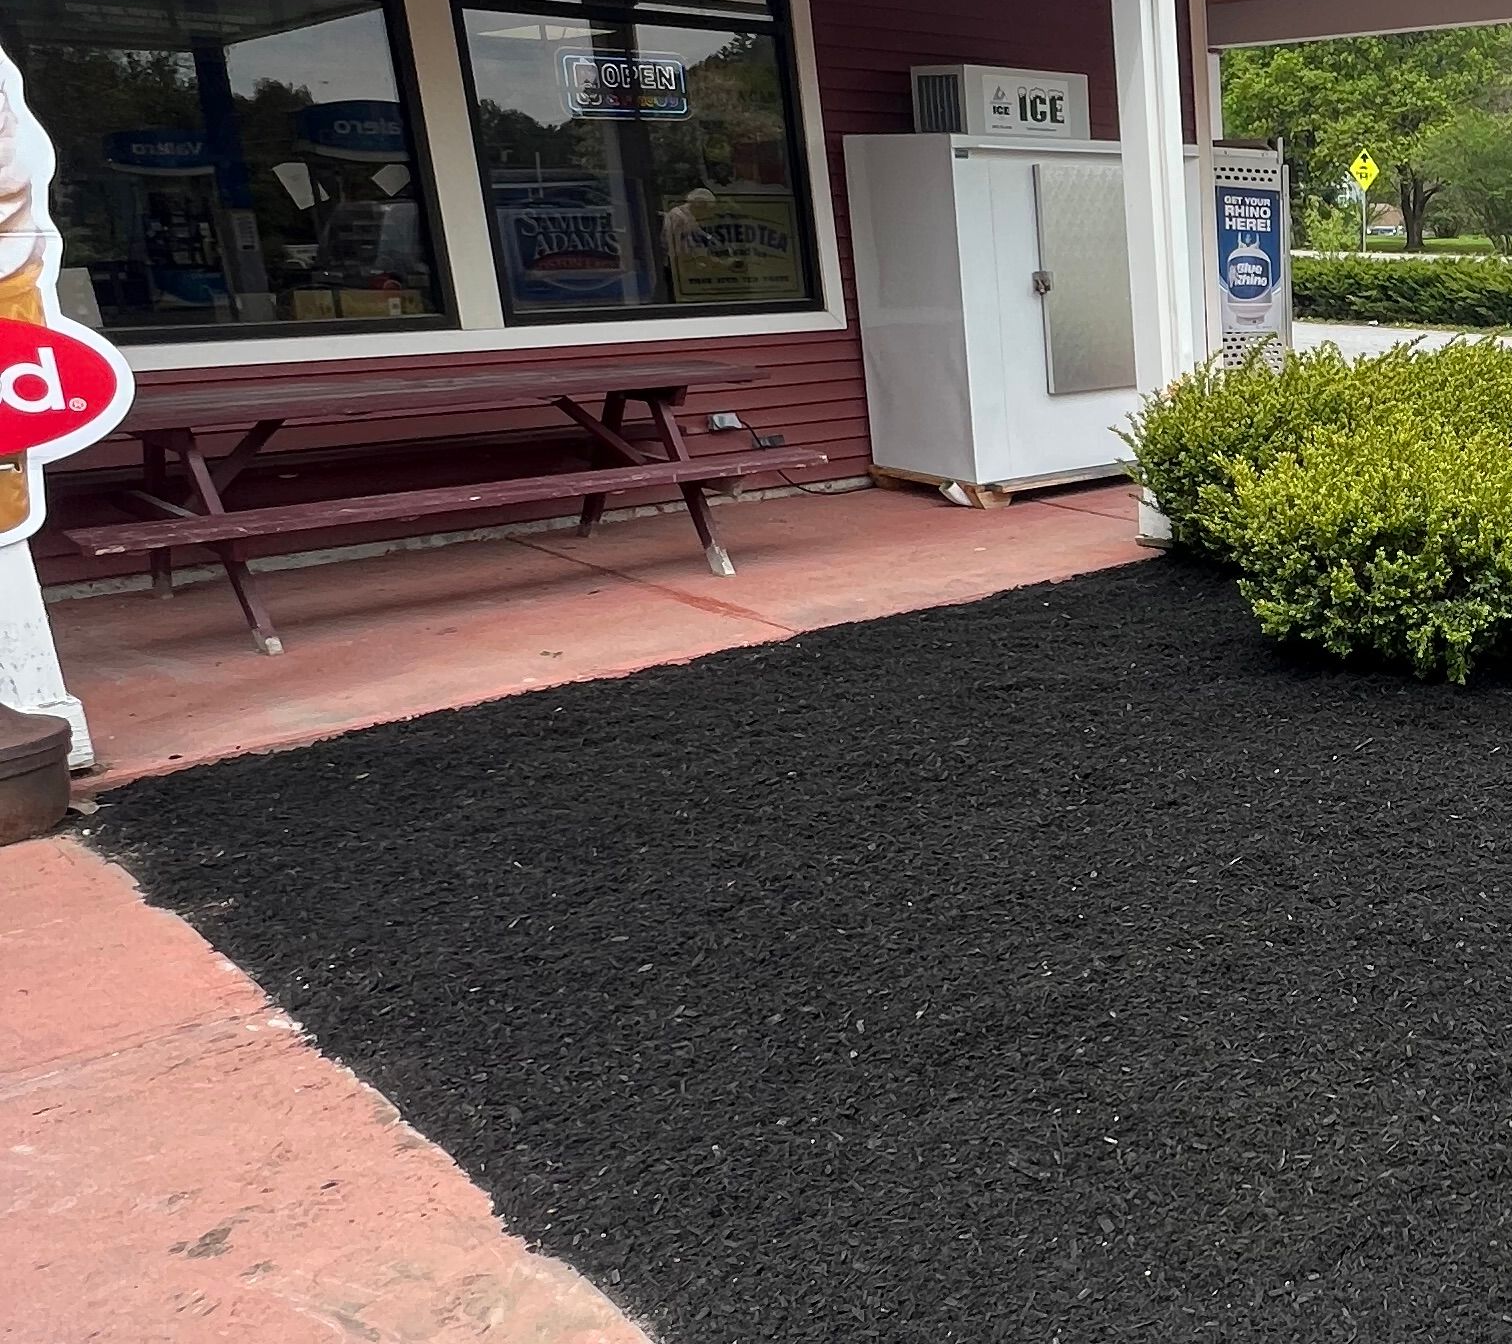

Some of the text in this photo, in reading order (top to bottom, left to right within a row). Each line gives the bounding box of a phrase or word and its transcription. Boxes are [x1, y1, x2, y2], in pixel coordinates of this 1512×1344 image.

[601, 63, 676, 90] OPEN
[993, 106, 1011, 115] ICE
[1017, 86, 1065, 124] ICE
[1224, 196, 1271, 206] GET YOUR
[1224, 205, 1271, 218] RHINO
[520, 208, 626, 236] SAMUEL
[1225, 217, 1271, 232] HERE!
[534, 232, 622, 259] ADAMS
[681, 223, 755, 249] STED
